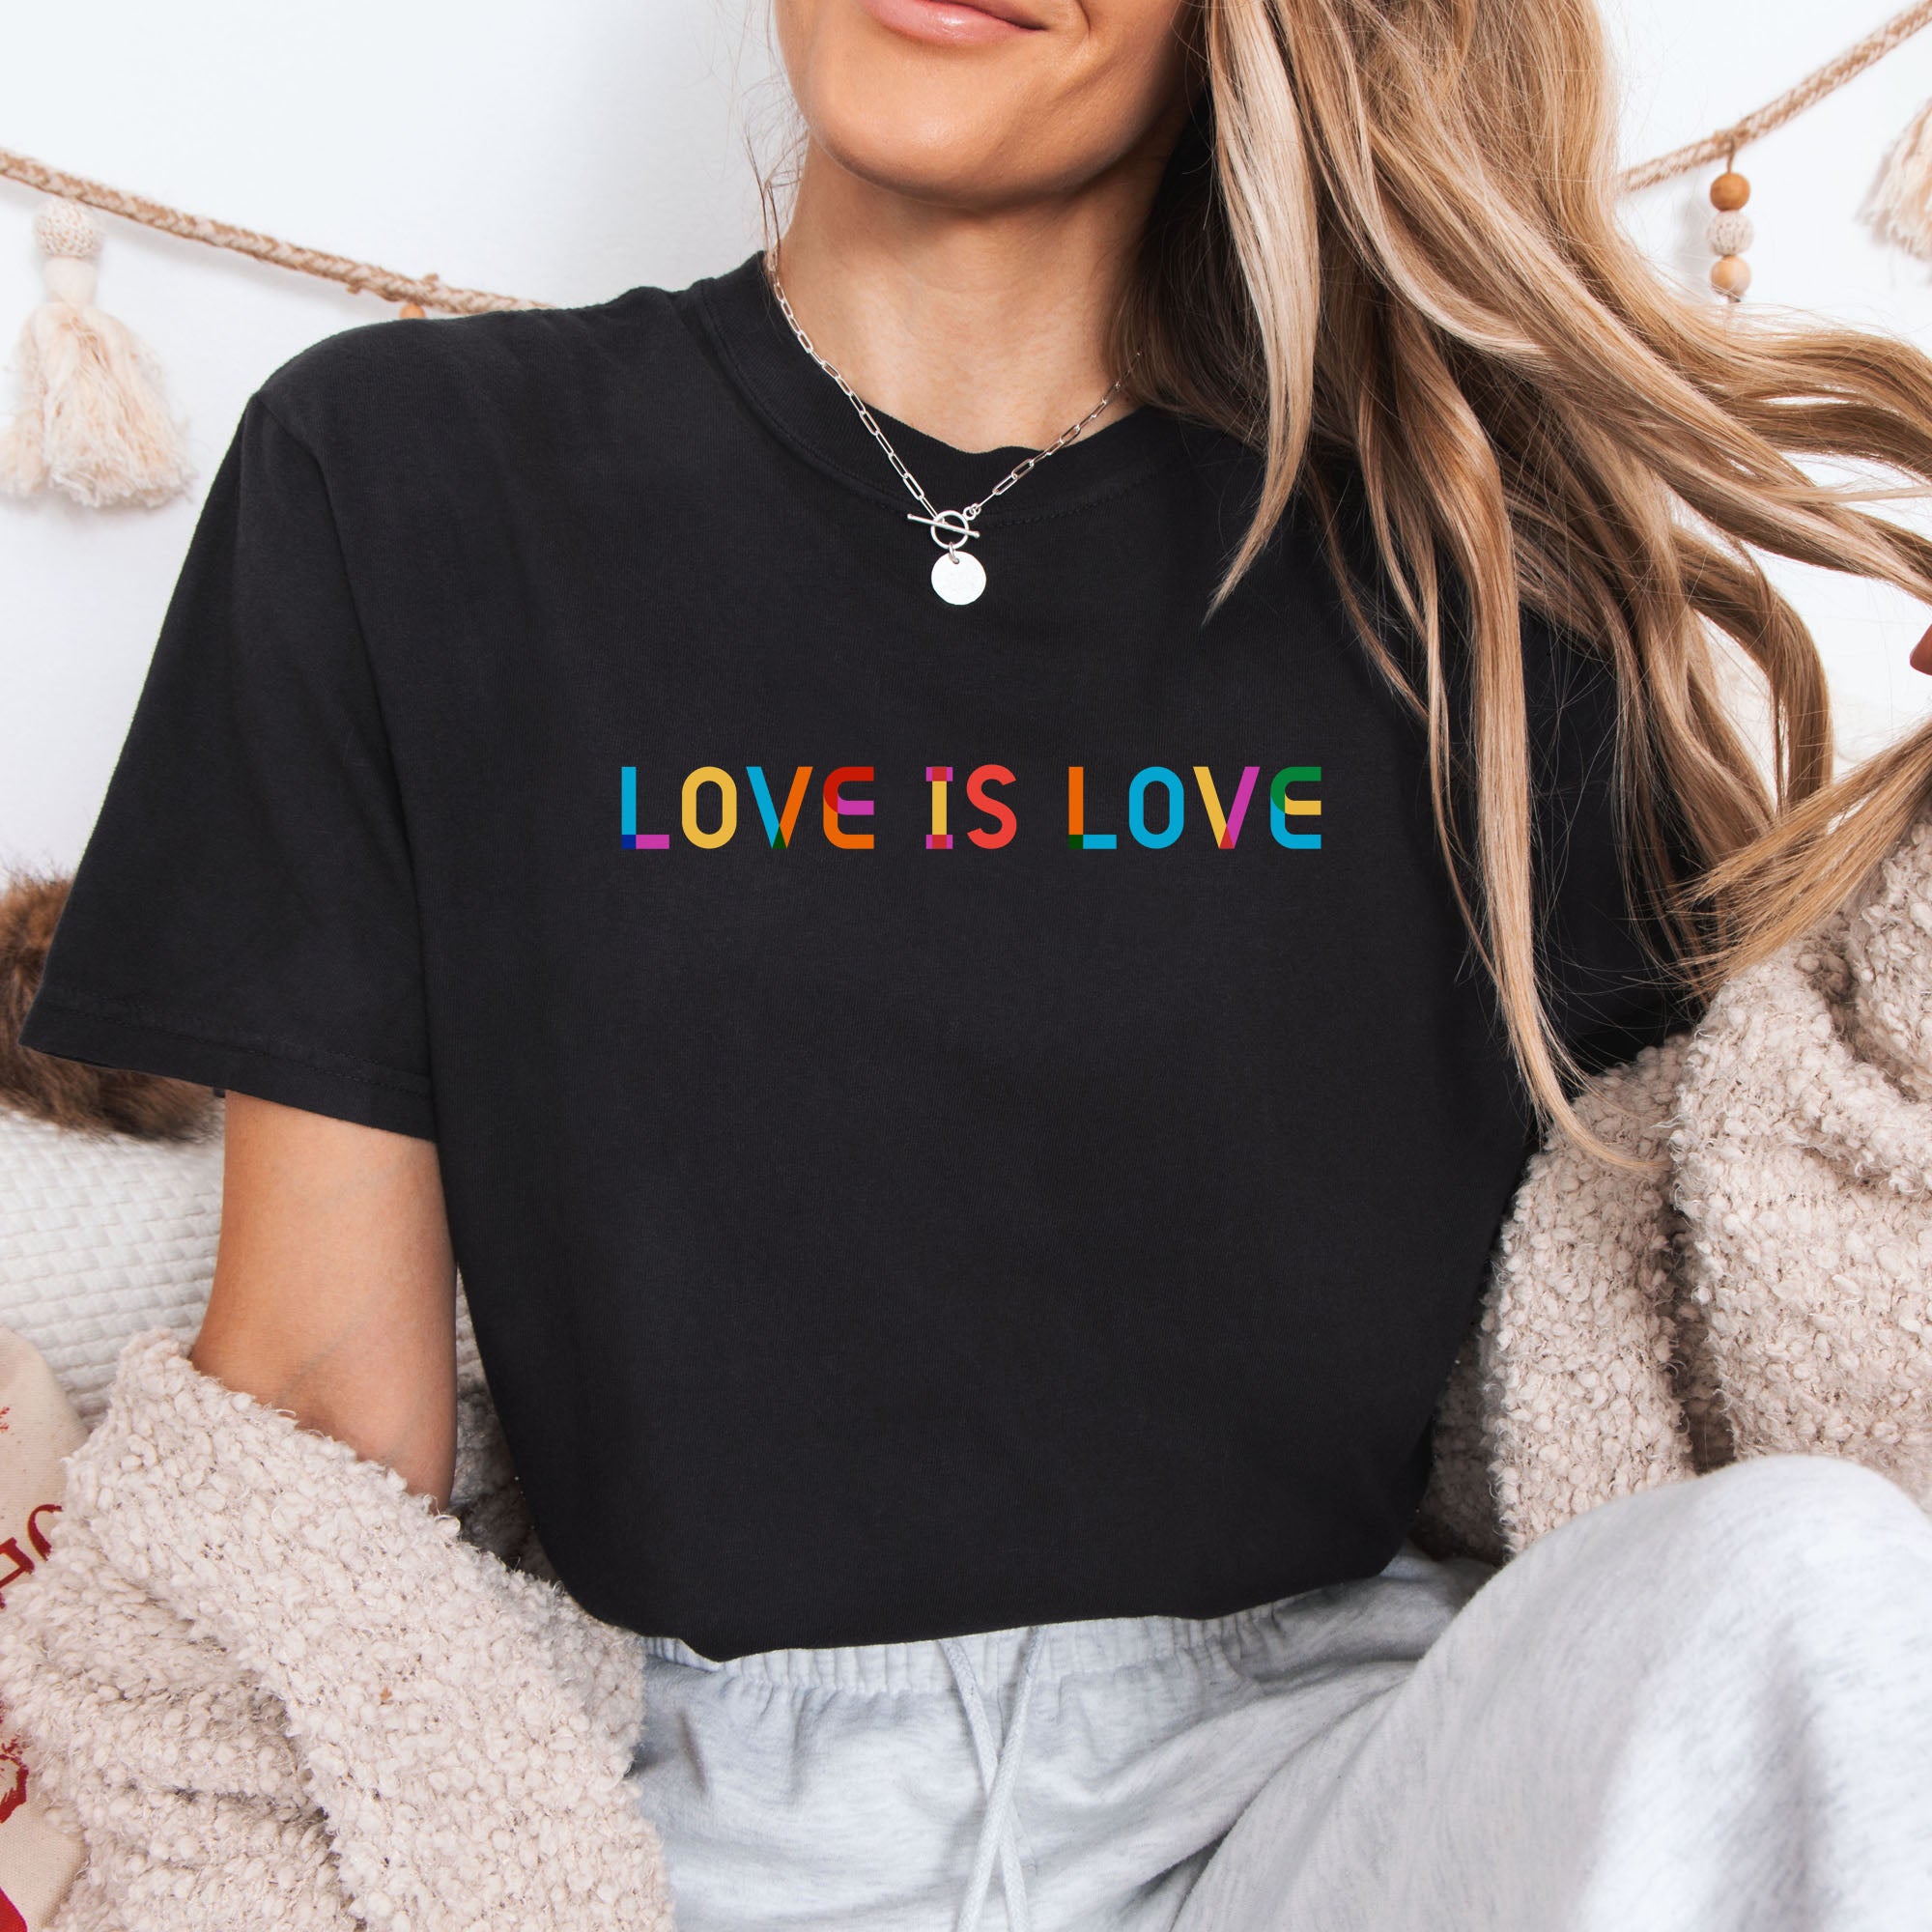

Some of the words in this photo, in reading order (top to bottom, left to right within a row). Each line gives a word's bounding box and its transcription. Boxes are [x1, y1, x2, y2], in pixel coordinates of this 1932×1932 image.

[620, 765, 875, 850] LOVE
[924, 763, 1018, 850] IS
[1067, 765, 1322, 850] LOVE
